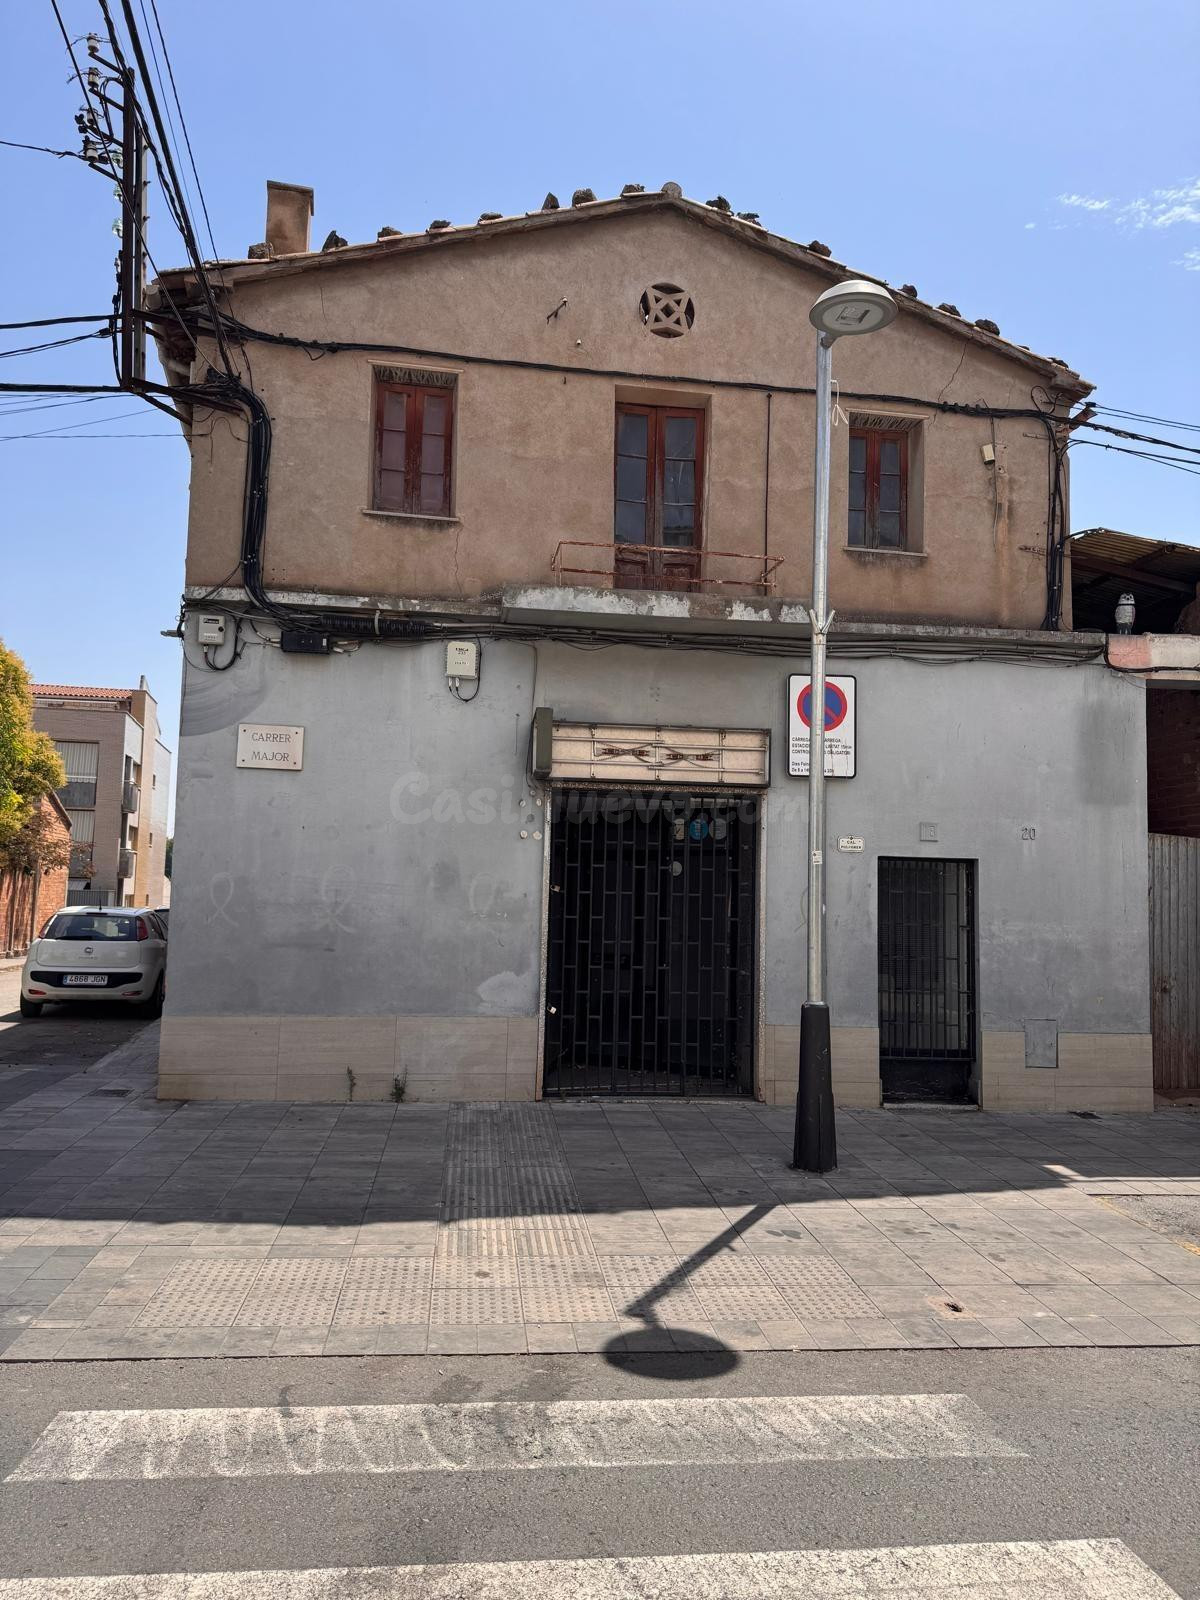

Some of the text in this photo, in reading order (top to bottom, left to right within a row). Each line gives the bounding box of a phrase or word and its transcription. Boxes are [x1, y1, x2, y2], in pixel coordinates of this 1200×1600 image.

[251, 732, 292, 743] CARRER
[251, 751, 290, 762] MAJOR
[1021, 827, 1036, 841] 20
[69, 975, 106, 983] 4868 JGN
